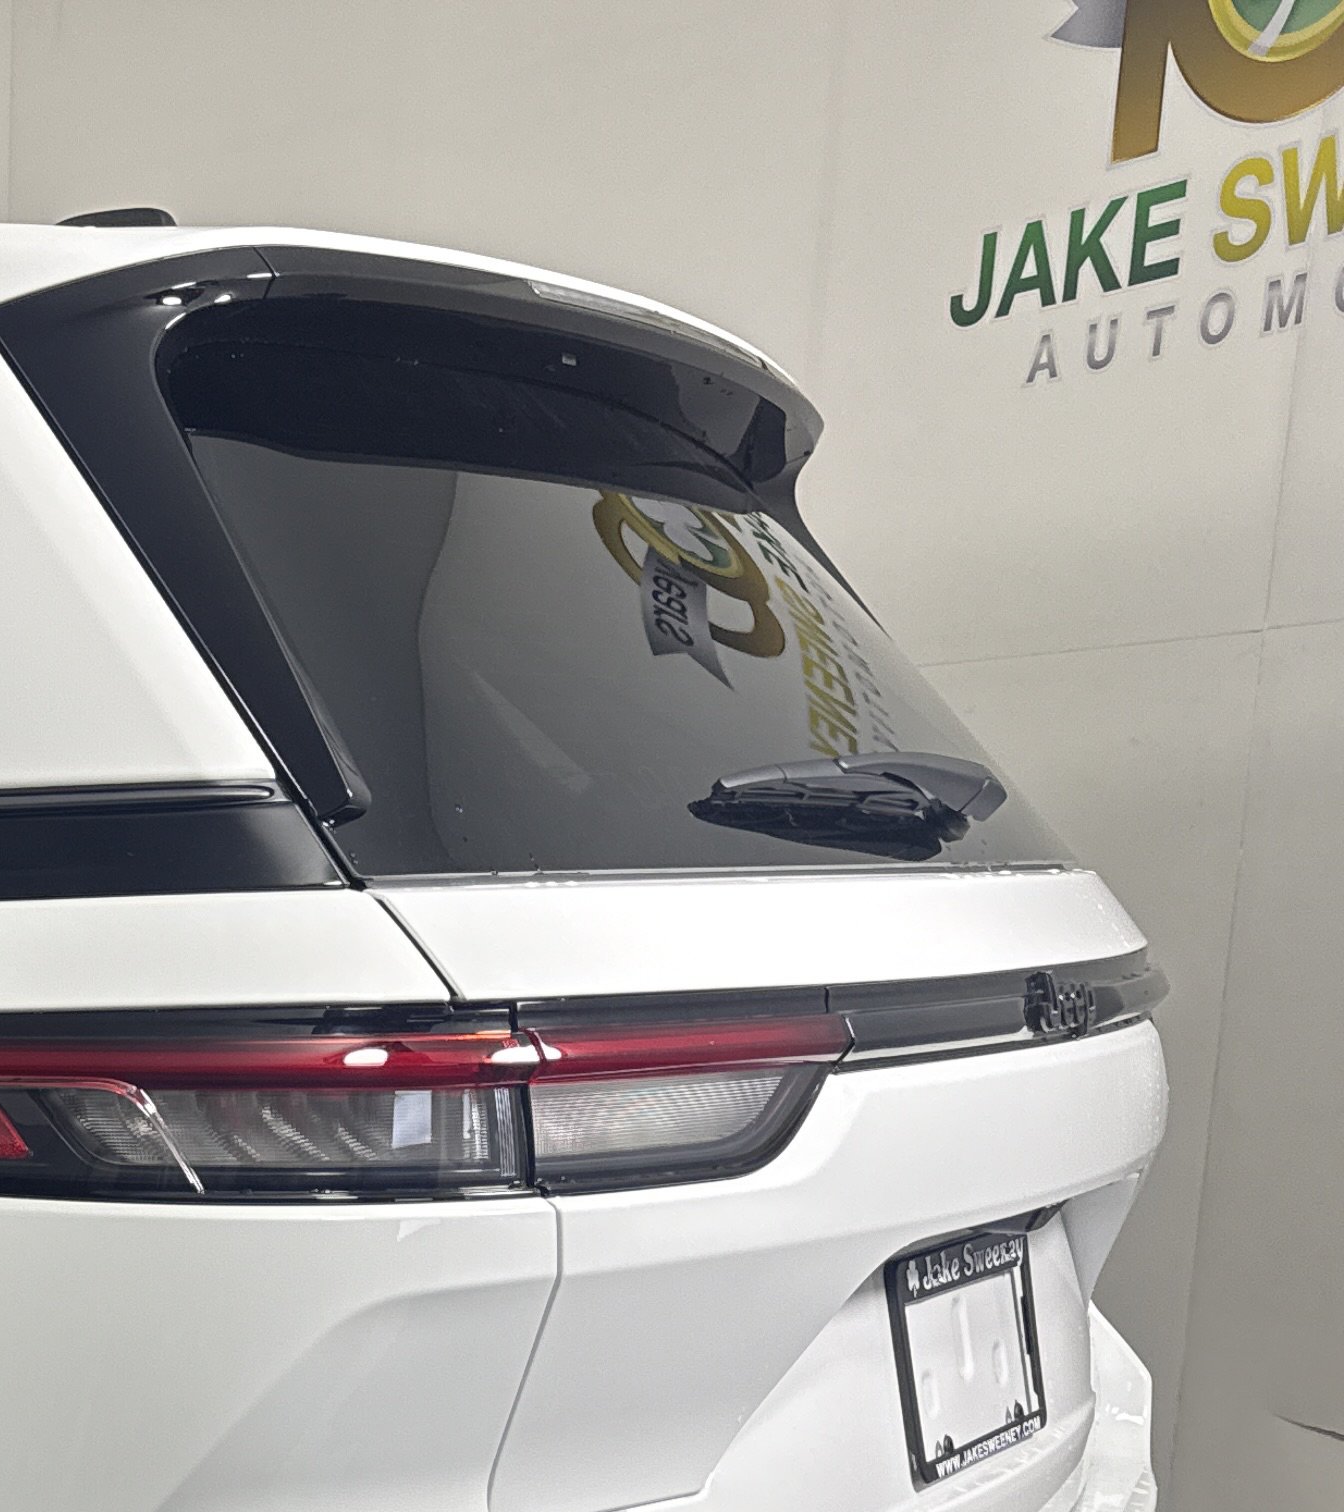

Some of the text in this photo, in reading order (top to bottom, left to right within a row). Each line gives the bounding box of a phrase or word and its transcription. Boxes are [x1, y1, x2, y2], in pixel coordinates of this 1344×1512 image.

[949, 179, 1189, 328] JAKE
[1025, 268, 1344, 384] AUTOM
[922, 1250, 961, 1290] Jake
[935, 1415, 1041, 1479] WWW.JAKESWEENEY.COM
